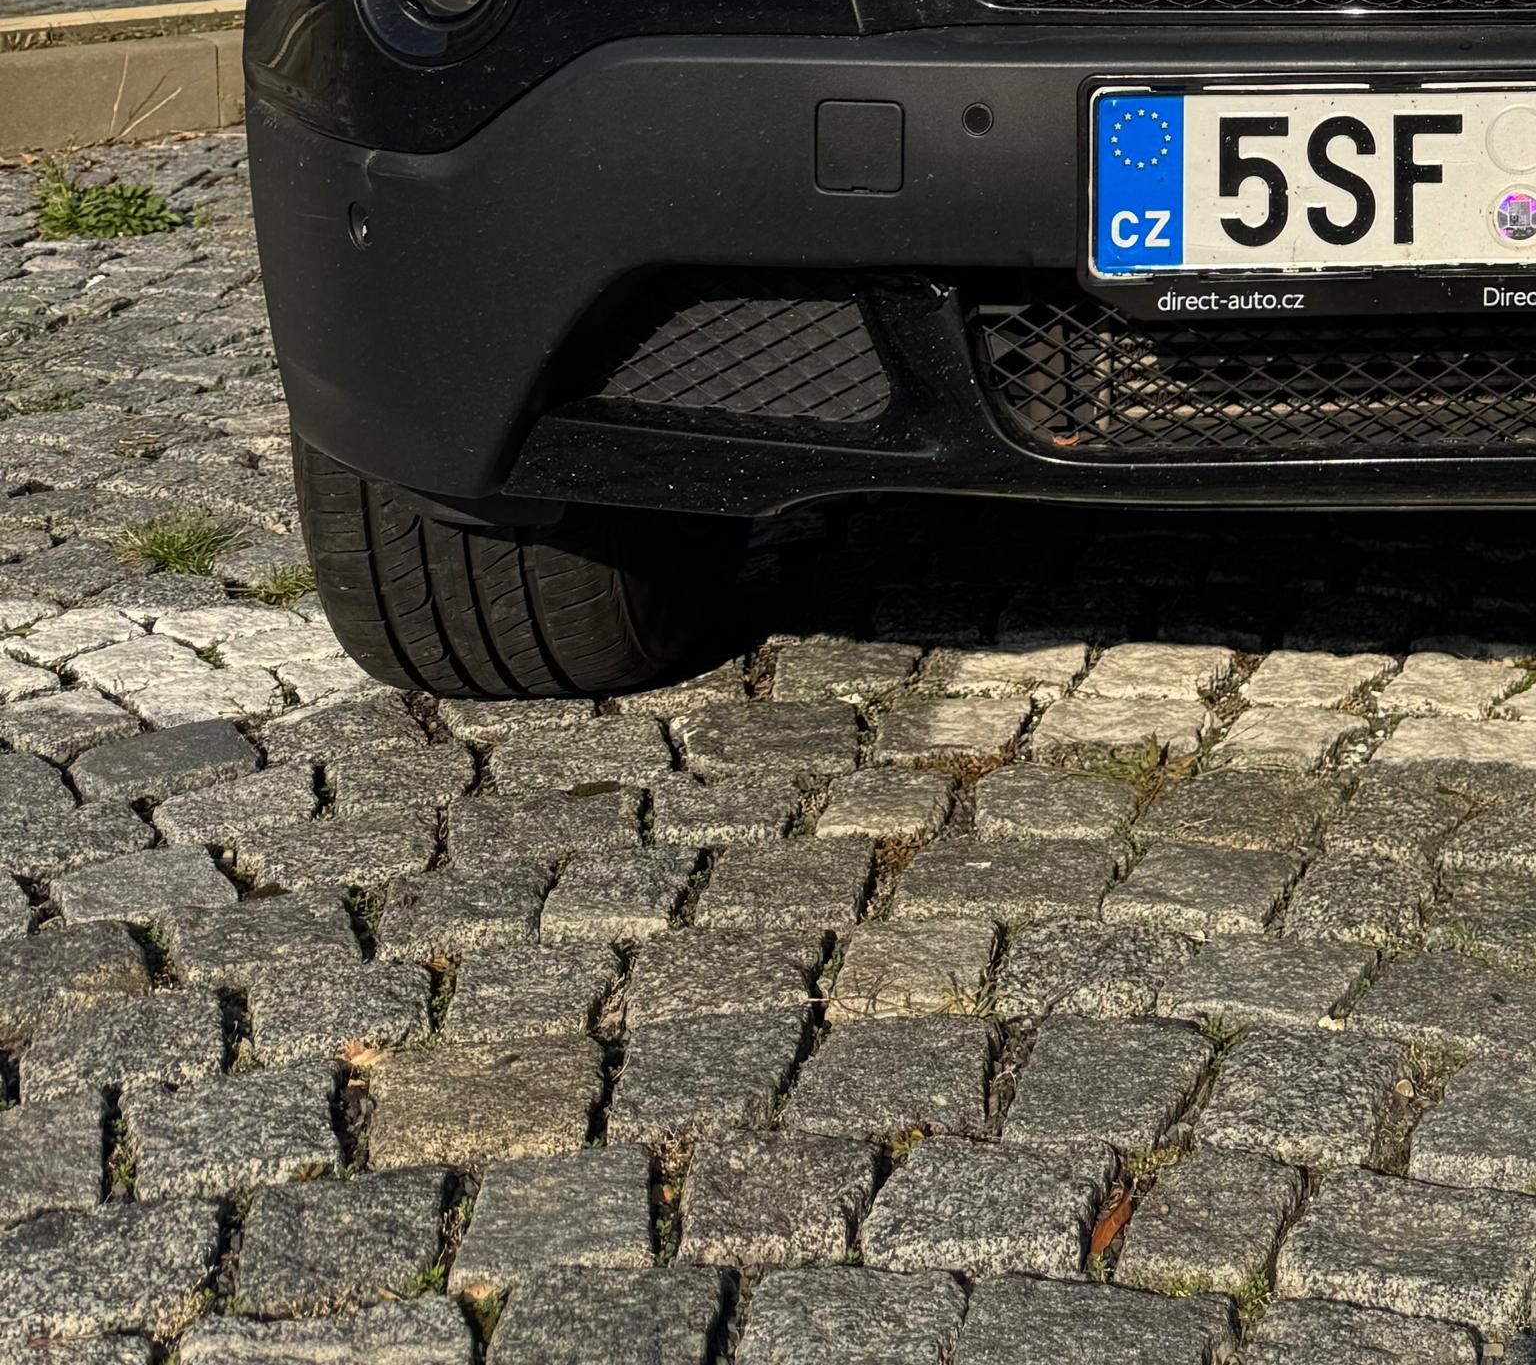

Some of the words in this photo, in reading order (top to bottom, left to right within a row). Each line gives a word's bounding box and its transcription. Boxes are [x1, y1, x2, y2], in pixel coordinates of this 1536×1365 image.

[1219, 114, 1463, 247] 5SF
[1111, 210, 1171, 248] CZ
[1157, 291, 1305, 311] direct-auto.cz
